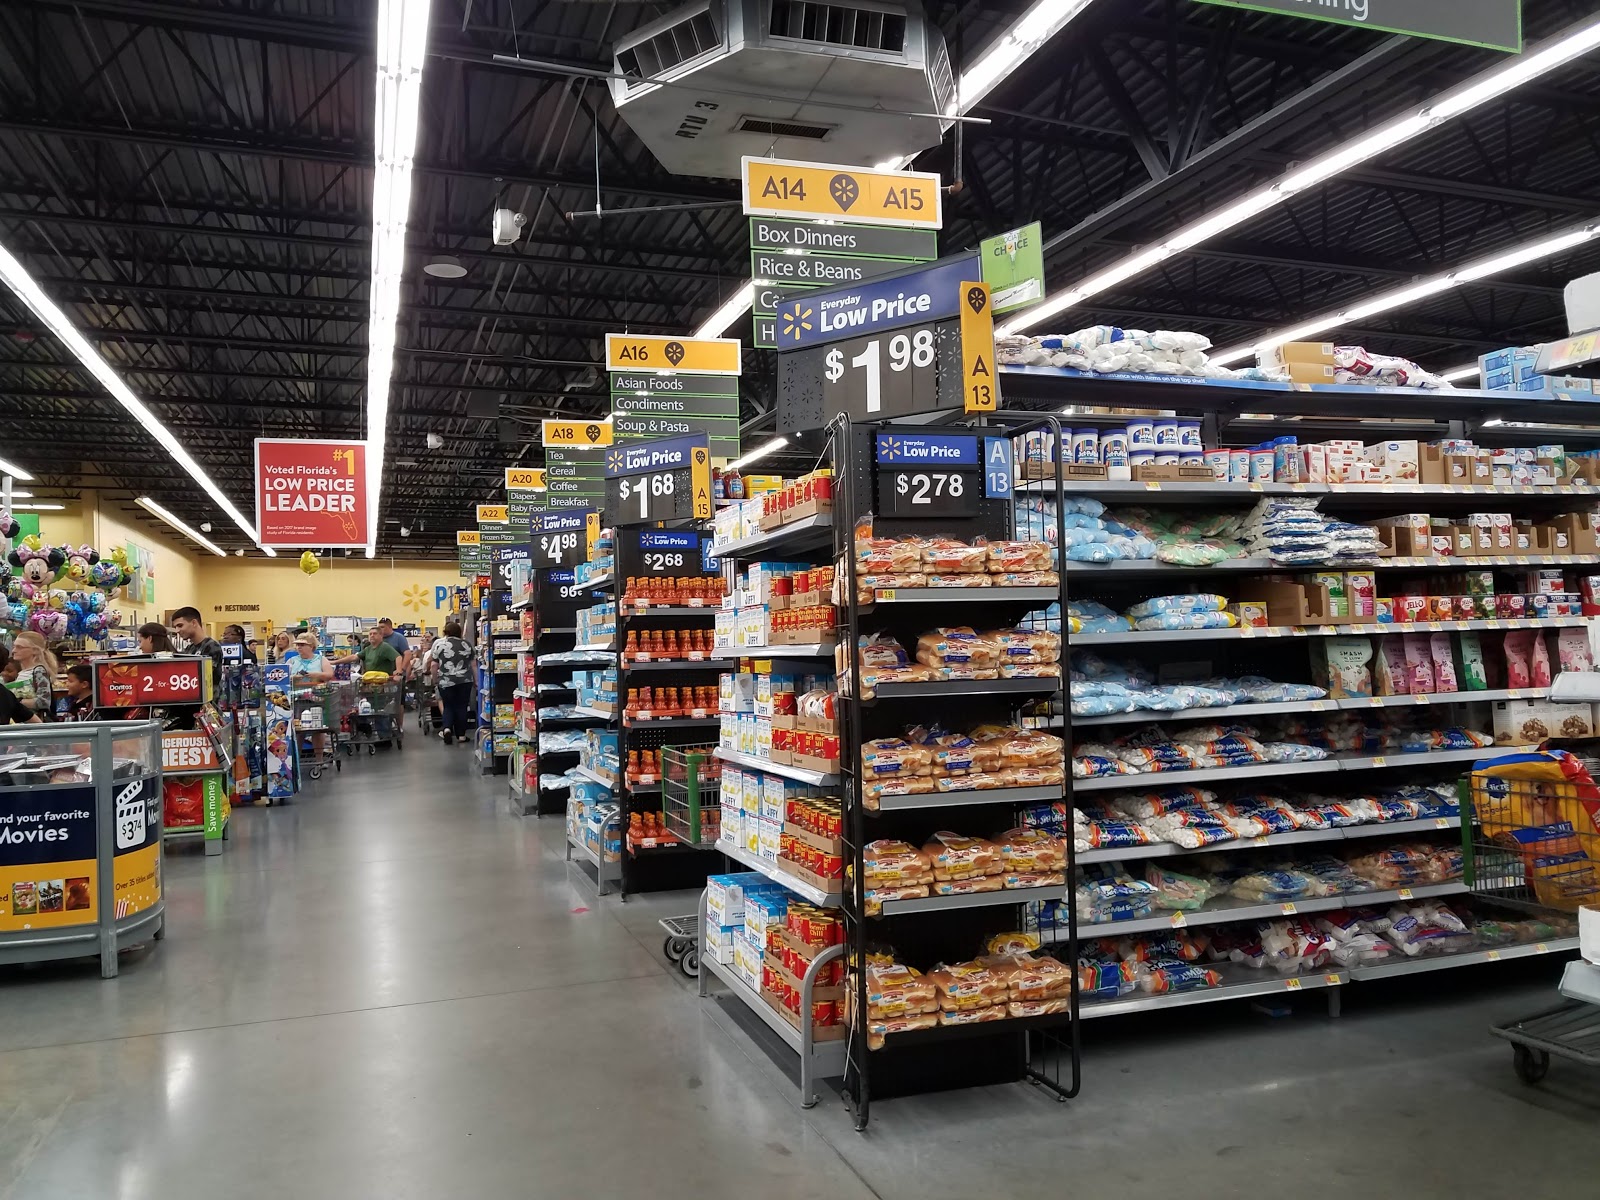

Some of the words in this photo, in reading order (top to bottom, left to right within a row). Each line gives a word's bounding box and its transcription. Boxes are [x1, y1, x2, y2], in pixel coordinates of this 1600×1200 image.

[761, 175, 807, 201] A14
[883, 186, 924, 211] A15
[758, 225, 790, 243] Box
[794, 228, 857, 248] Dinners
[760, 258, 793, 276] Rice
[797, 261, 811, 277] &
[814, 262, 862, 281] Beans
[820, 294, 861, 311] Everyday
[820, 306, 867, 333] Low
[872, 293, 931, 321] Price
[619, 345, 648, 361] A16
[972, 355, 989, 377] A
[616, 377, 646, 389] Asian
[650, 378, 683, 390] Foods
[972, 385, 991, 405] 13
[616, 398, 684, 411] Condiments
[617, 419, 646, 432] Soup
[649, 421, 658, 432] &
[660, 421, 690, 432] Pasta
[552, 428, 574, 439] A18
[549, 451, 564, 460] Tea
[903, 446, 929, 458] Low
[931, 445, 961, 458] Price
[990, 440, 1006, 463] A
[333, 449, 355, 475] #1
[626, 456, 650, 470] Low
[652, 450, 682, 466] Price
[265, 465, 294, 474] Voted
[297, 466, 337, 475] Florida's
[550, 467, 576, 475] Cereal
[265, 478, 302, 490] LOW
[307, 478, 355, 491] PRICE
[511, 474, 532, 484] A20
[988, 472, 1008, 493] 13
[550, 482, 578, 491] Coffee
[511, 492, 536, 500] Diapers
[698, 488, 707, 499] A
[265, 494, 355, 512] LEADER
[551, 497, 589, 506] Breakfast
[482, 510, 498, 518] A22
[511, 505, 528, 515] Baby
[697, 503, 709, 515] 15
[544, 520, 560, 529] Low
[561, 518, 581, 527] Price
[718, 535, 729, 546] JIFFY
[704, 558, 718, 569] 15
[1407, 600, 1424, 610] JELL-O
[143, 676, 154, 691] 2
[169, 674, 198, 691] 98¢
[724, 793, 736, 806] JIFFY
[17, 815, 41, 825] your
[44, 810, 90, 821] favorite
[767, 805, 778, 819] JIFFY
[208, 810, 217, 832] Save
[763, 846, 775, 861] JIFFY
[115, 881, 128, 891] Over
